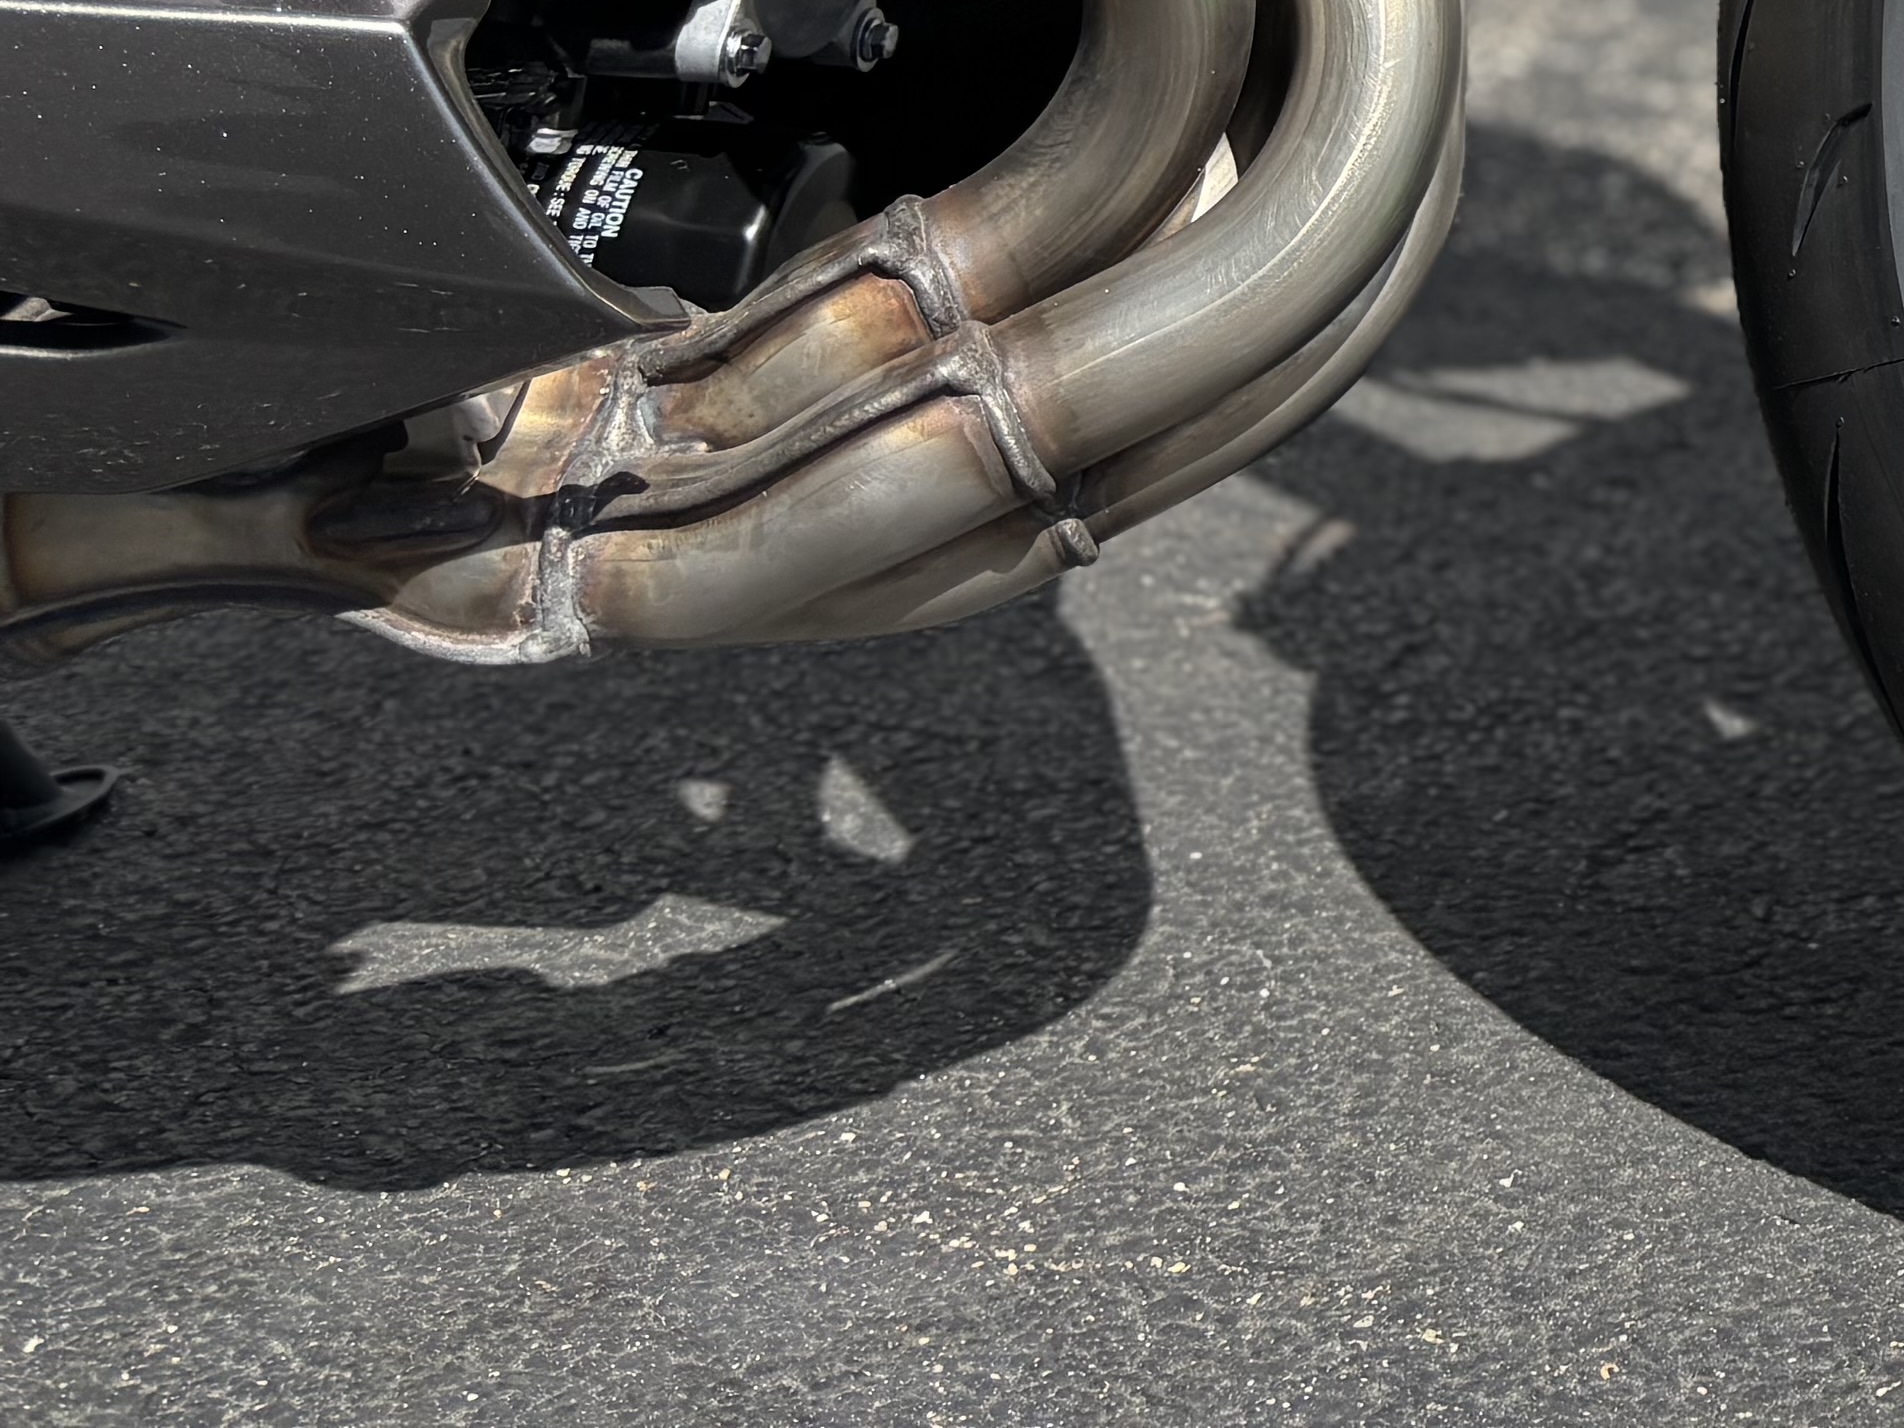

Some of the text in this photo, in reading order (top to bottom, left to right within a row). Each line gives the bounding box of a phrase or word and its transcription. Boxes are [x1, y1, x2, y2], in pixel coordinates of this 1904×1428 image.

[601, 168, 644, 238] CAUTION
[573, 208, 591, 229] AND
[582, 235, 599, 249] TO
